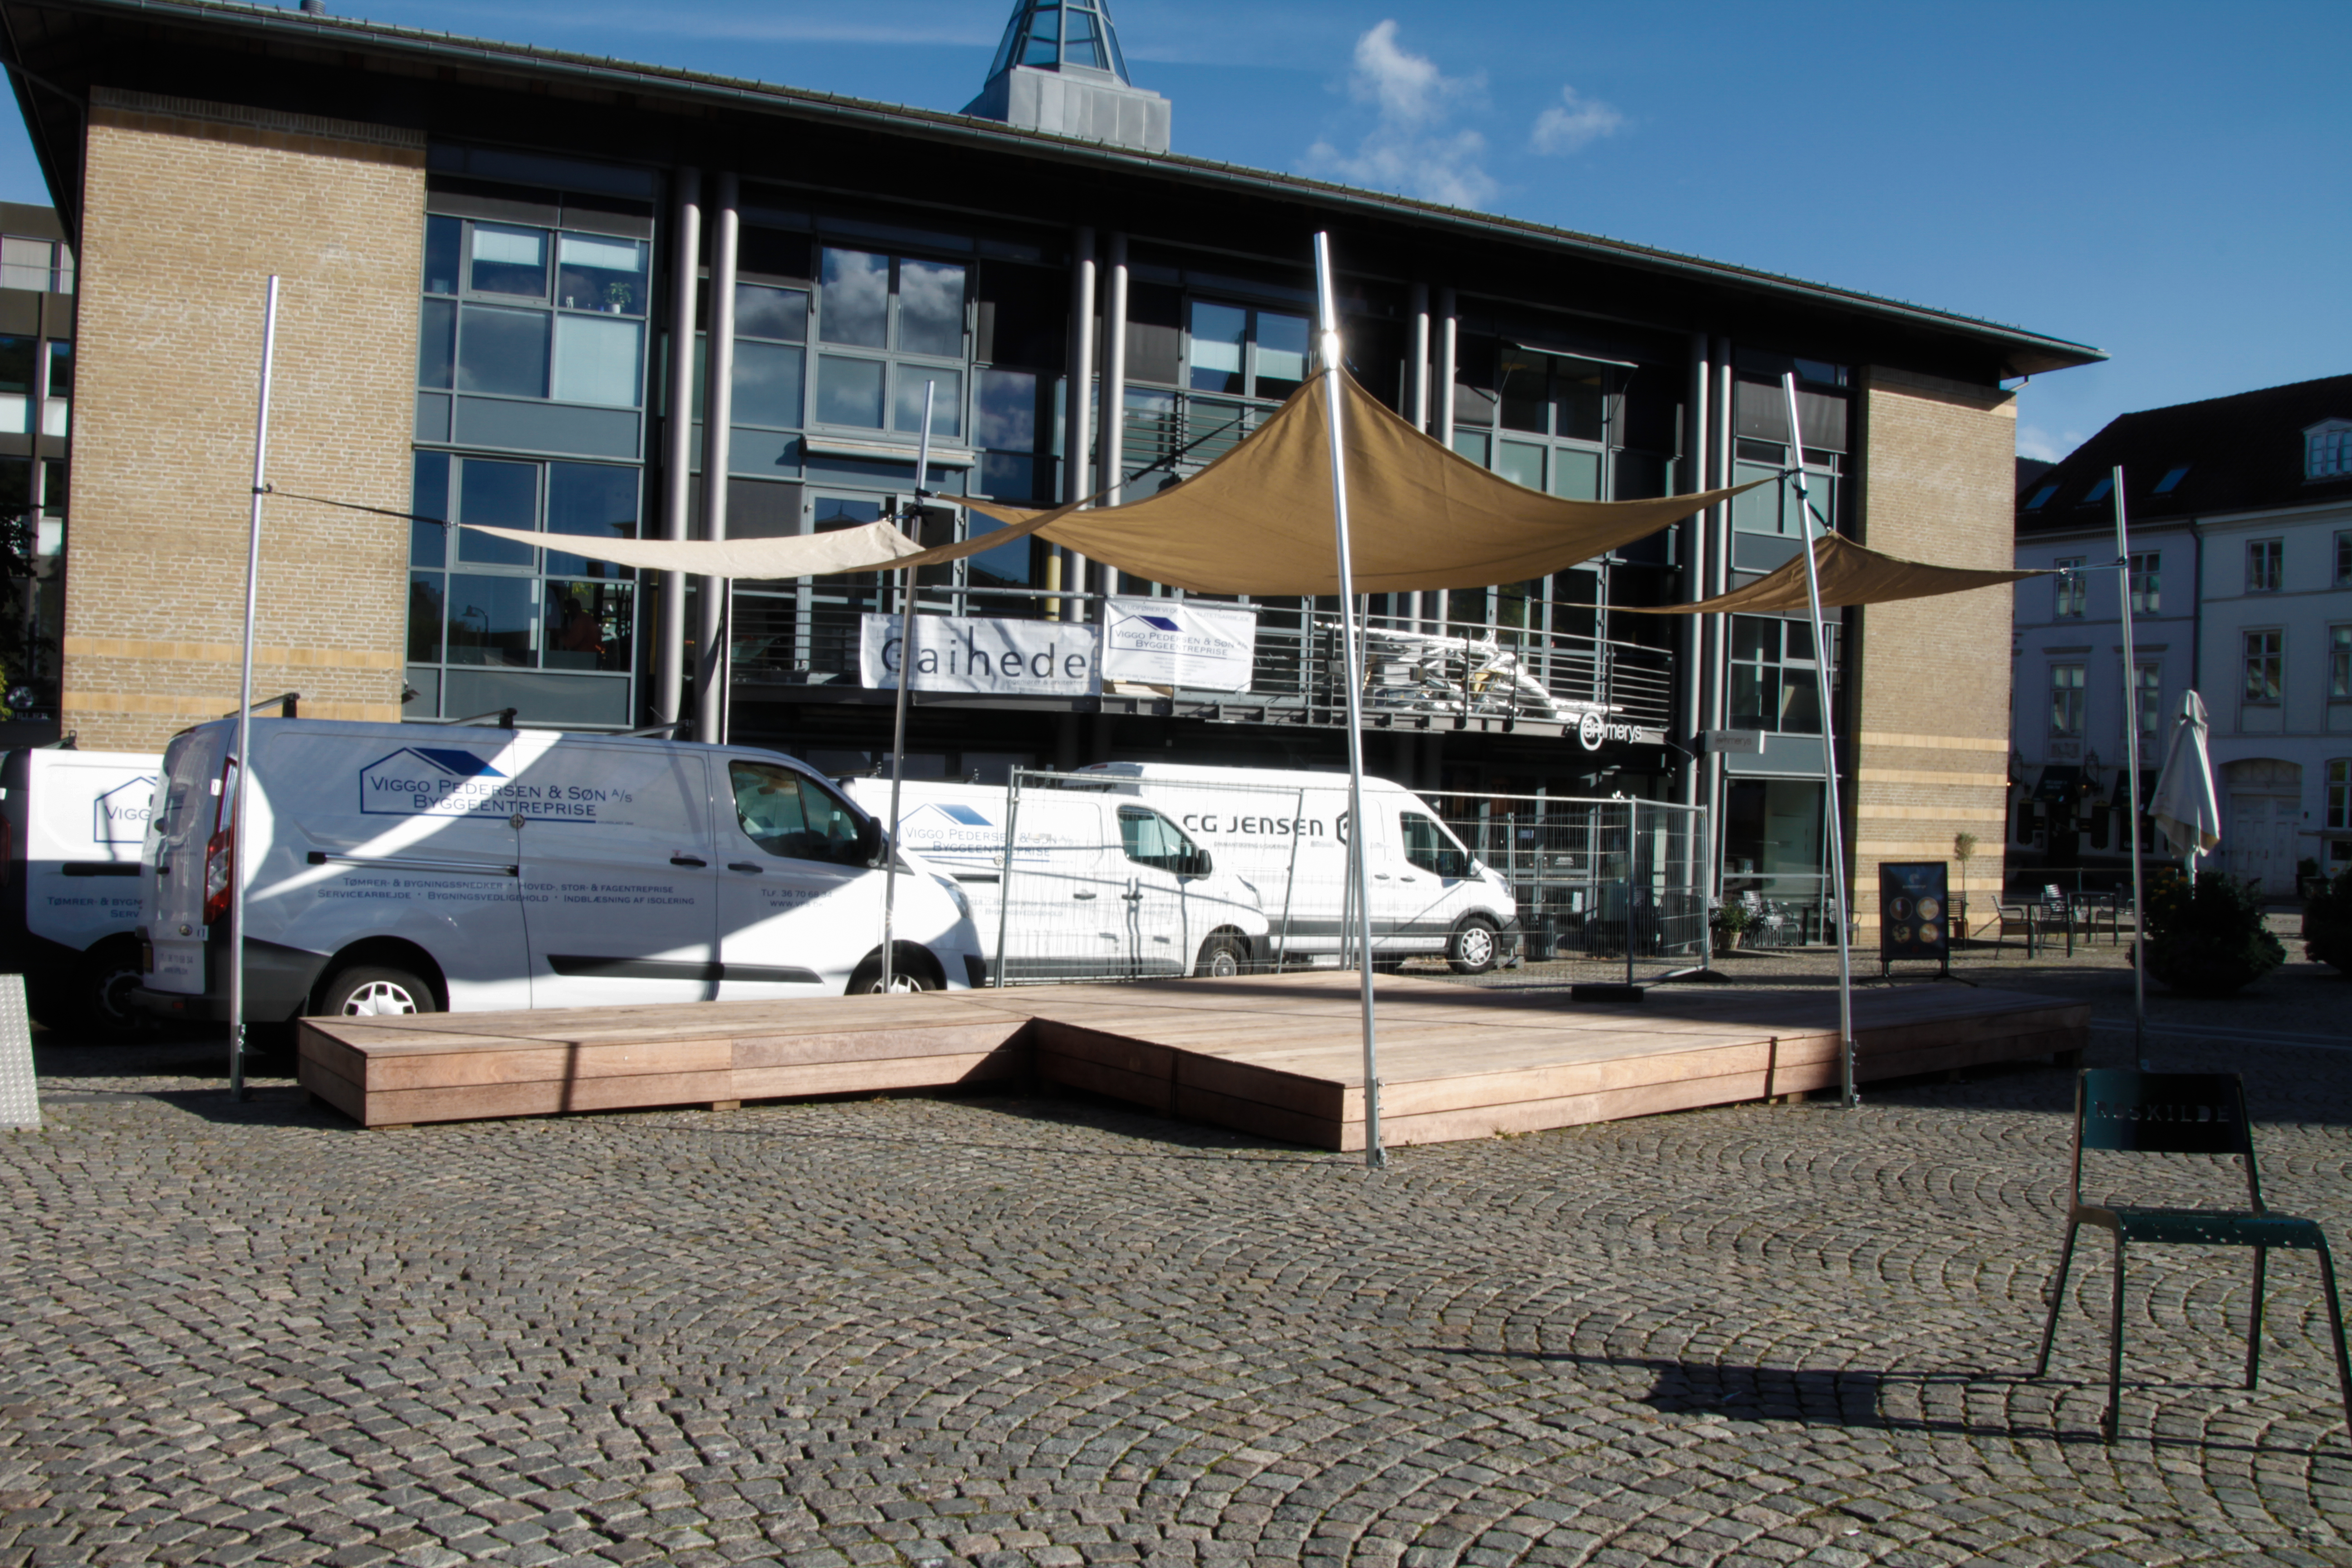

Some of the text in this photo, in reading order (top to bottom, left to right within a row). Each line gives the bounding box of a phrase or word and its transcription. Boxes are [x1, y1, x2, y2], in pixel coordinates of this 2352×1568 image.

[1115, 629, 1145, 639] VIGGO
[1149, 632, 1200, 645] PEDERSEN
[1214, 638, 1234, 648] SØN
[881, 626, 1087, 679] Gaihede
[1136, 640, 1228, 656] BYGGEENTREPRISE
[1582, 719, 1642, 745] emmerys
[1715, 736, 1752, 747] emmerys
[370, 776, 633, 803] VIGGO PEDERSEN & SØN A/S
[104, 805, 152, 820] VIGG
[414, 794, 596, 816] BYGGEENTREPRISE
[1182, 814, 1217, 833] CG
[906, 827, 944, 839] VIGGO
[949, 828, 1006, 842] PEDERSE
[1020, 832, 1028, 843] &
[343, 877, 390, 887] TØMRER-
[392, 879, 401, 887] &
[404, 881, 503, 889] BYGNINGSSNEDKER
[591, 883, 598, 892] &
[601, 885, 673, 893] FAGENTREPRISE
[47, 897, 142, 906] TØMRER- & BYGN
[318, 889, 411, 899] SERVICEARBEJDE
[428, 892, 549, 902] BYGNINGSVEDLIGEHOLD
[564, 894, 631, 904] INDBLÆSNING
[2095, 1101, 2230, 1122] ROSKILDE
